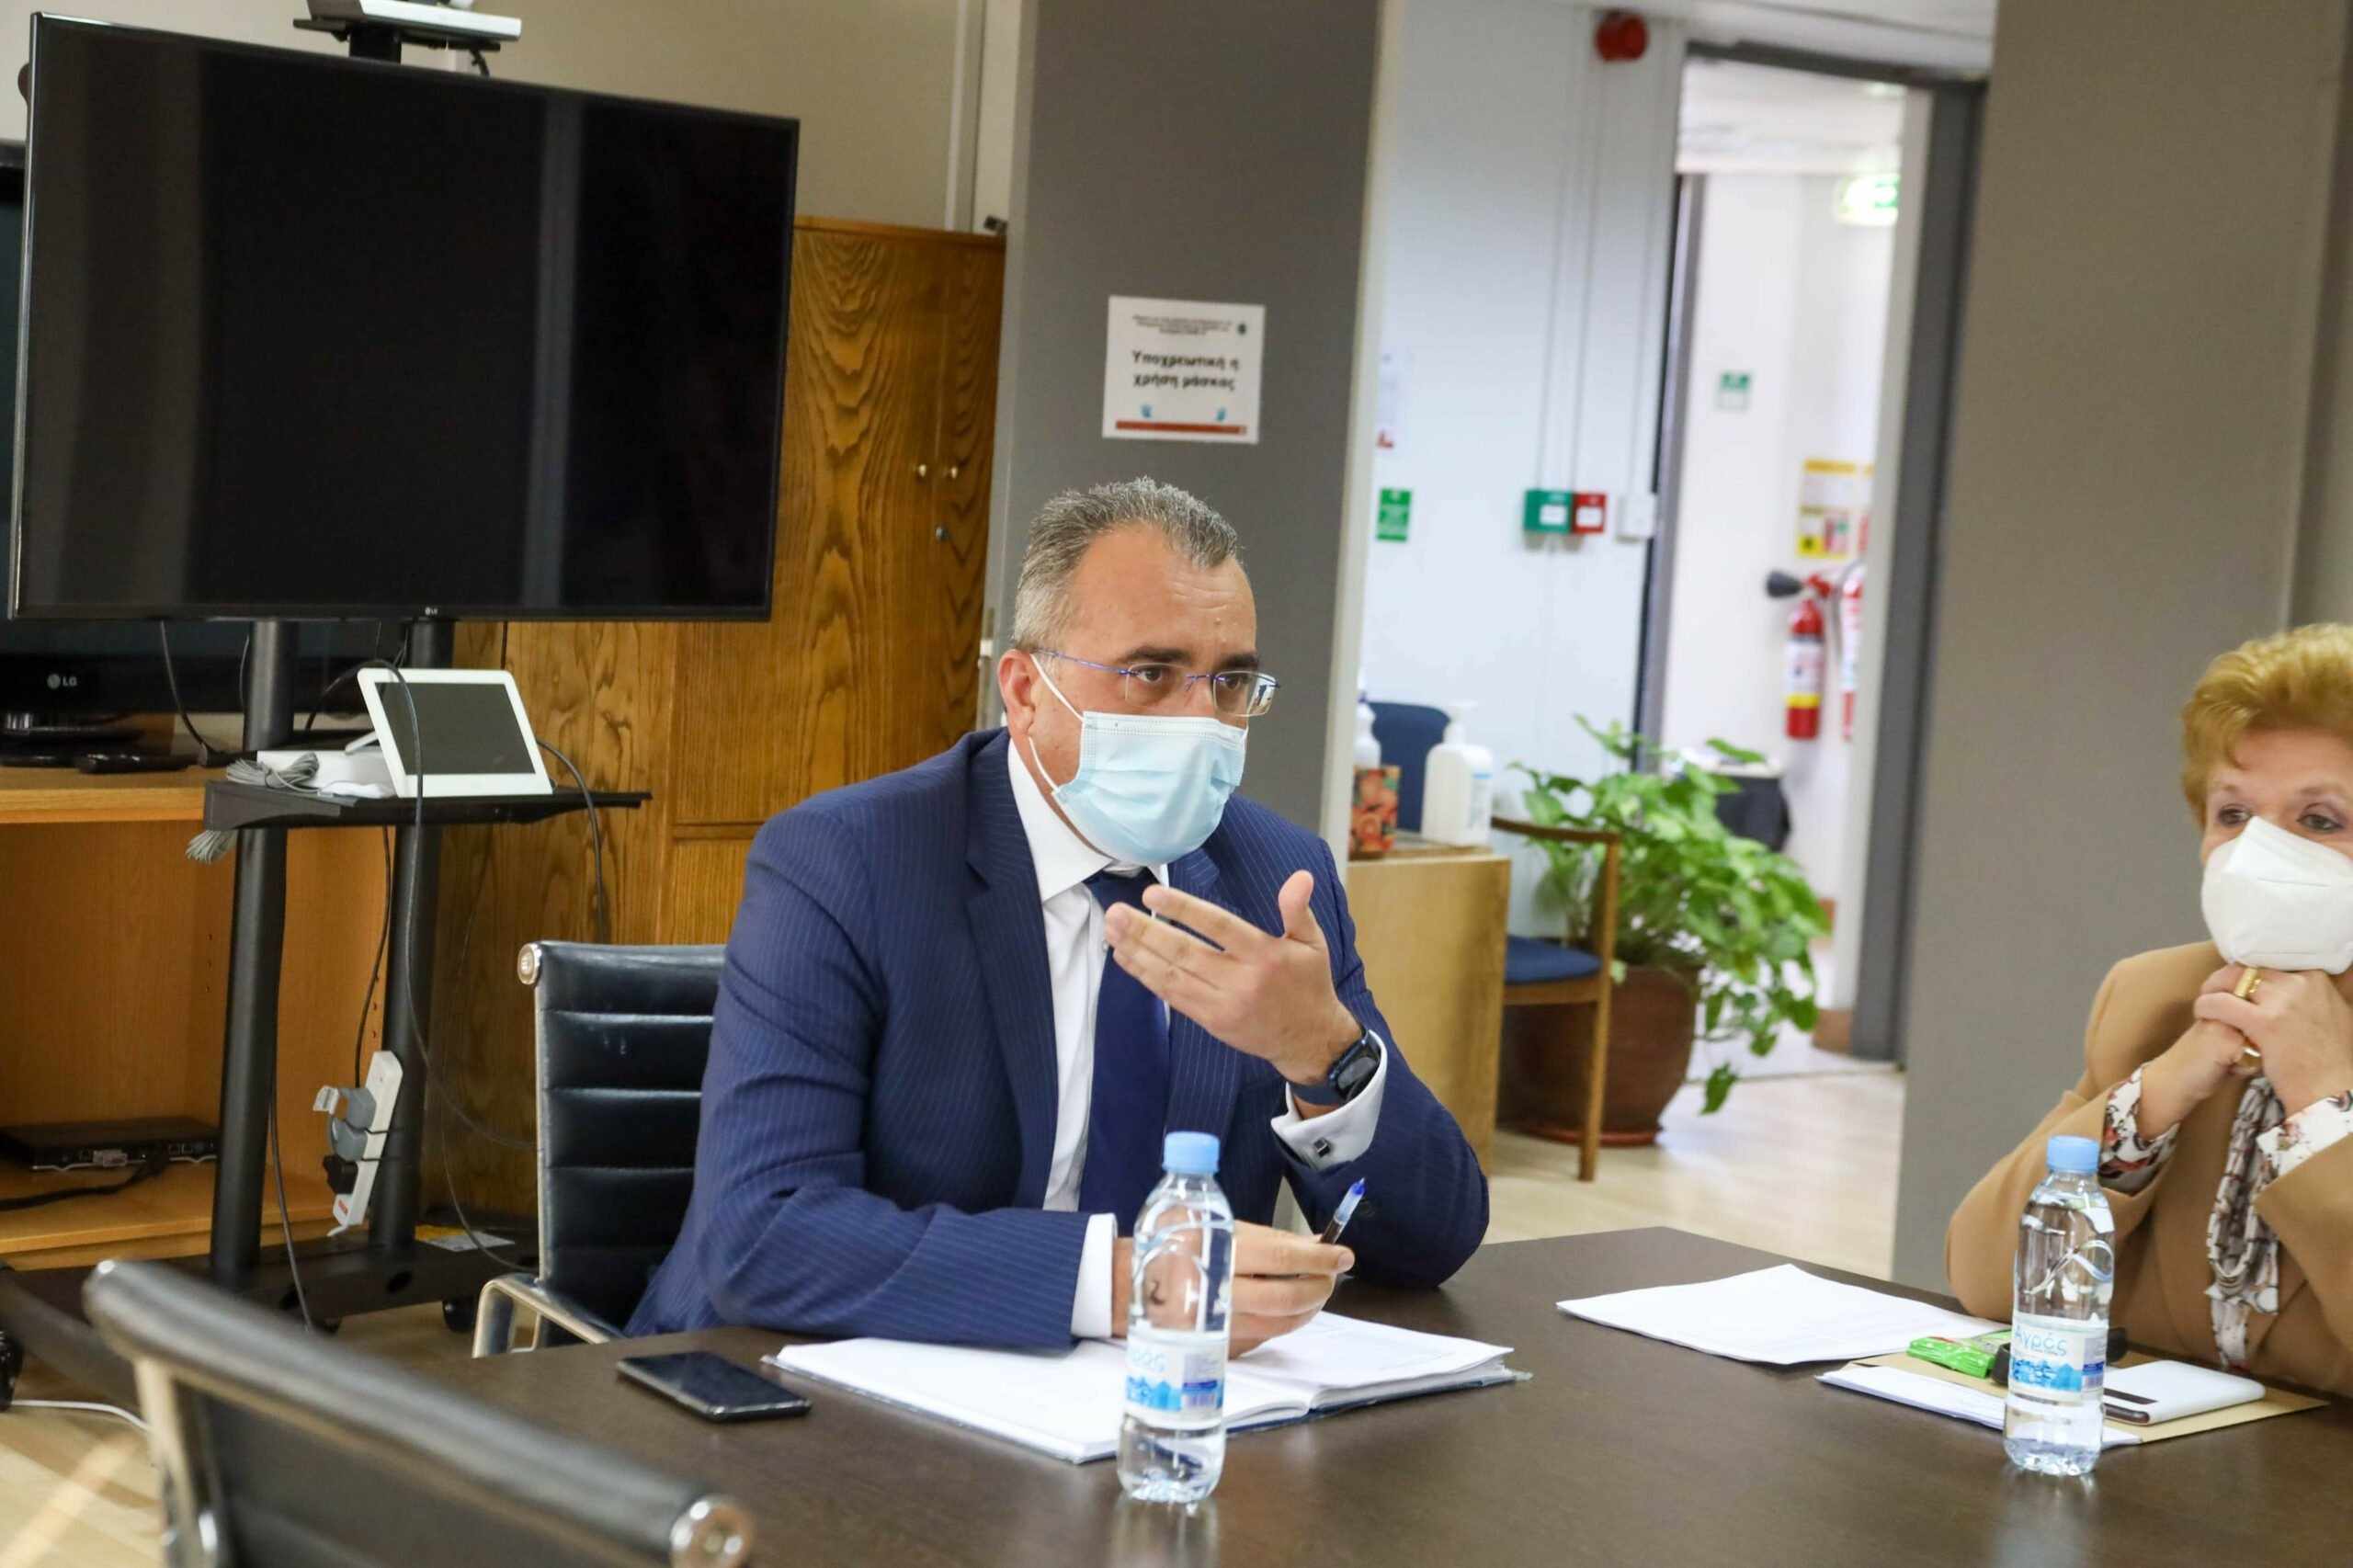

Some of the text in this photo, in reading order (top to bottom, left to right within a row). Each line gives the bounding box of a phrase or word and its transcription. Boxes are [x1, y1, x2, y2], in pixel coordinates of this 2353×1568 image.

[1131, 349, 1225, 370] Υποχρεωτική
[1133, 373, 1235, 392] χρήση μάσκας
[63, 676, 77, 687] LG
